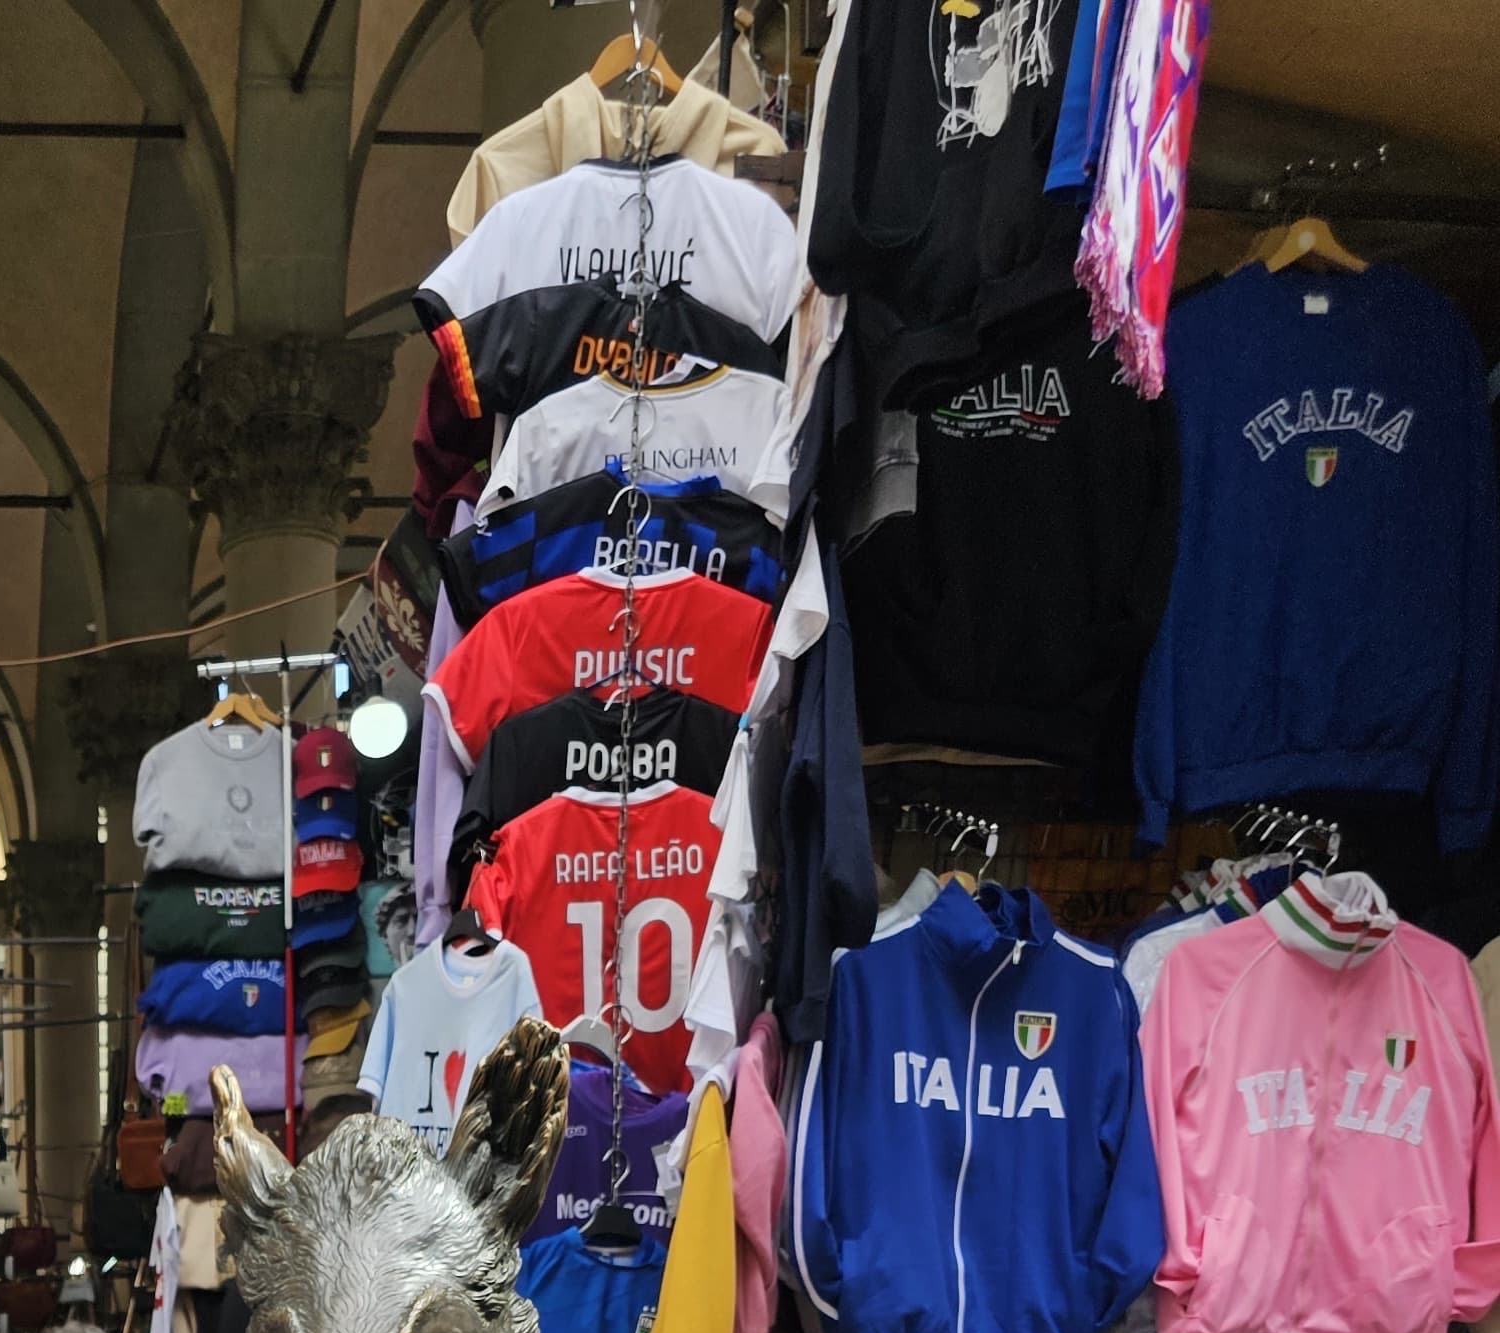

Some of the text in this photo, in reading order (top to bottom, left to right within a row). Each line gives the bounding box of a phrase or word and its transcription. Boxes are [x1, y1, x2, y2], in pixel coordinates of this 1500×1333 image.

[1243, 388, 1414, 461] ITALIA
[594, 537, 726, 582] BARELLA
[575, 648, 695, 687] PULISIC
[636, 839, 703, 880] LEÃO
[194, 886, 283, 907] FLORENCE
[566, 897, 693, 1032] 10
[418, 1051, 439, 1113] I
